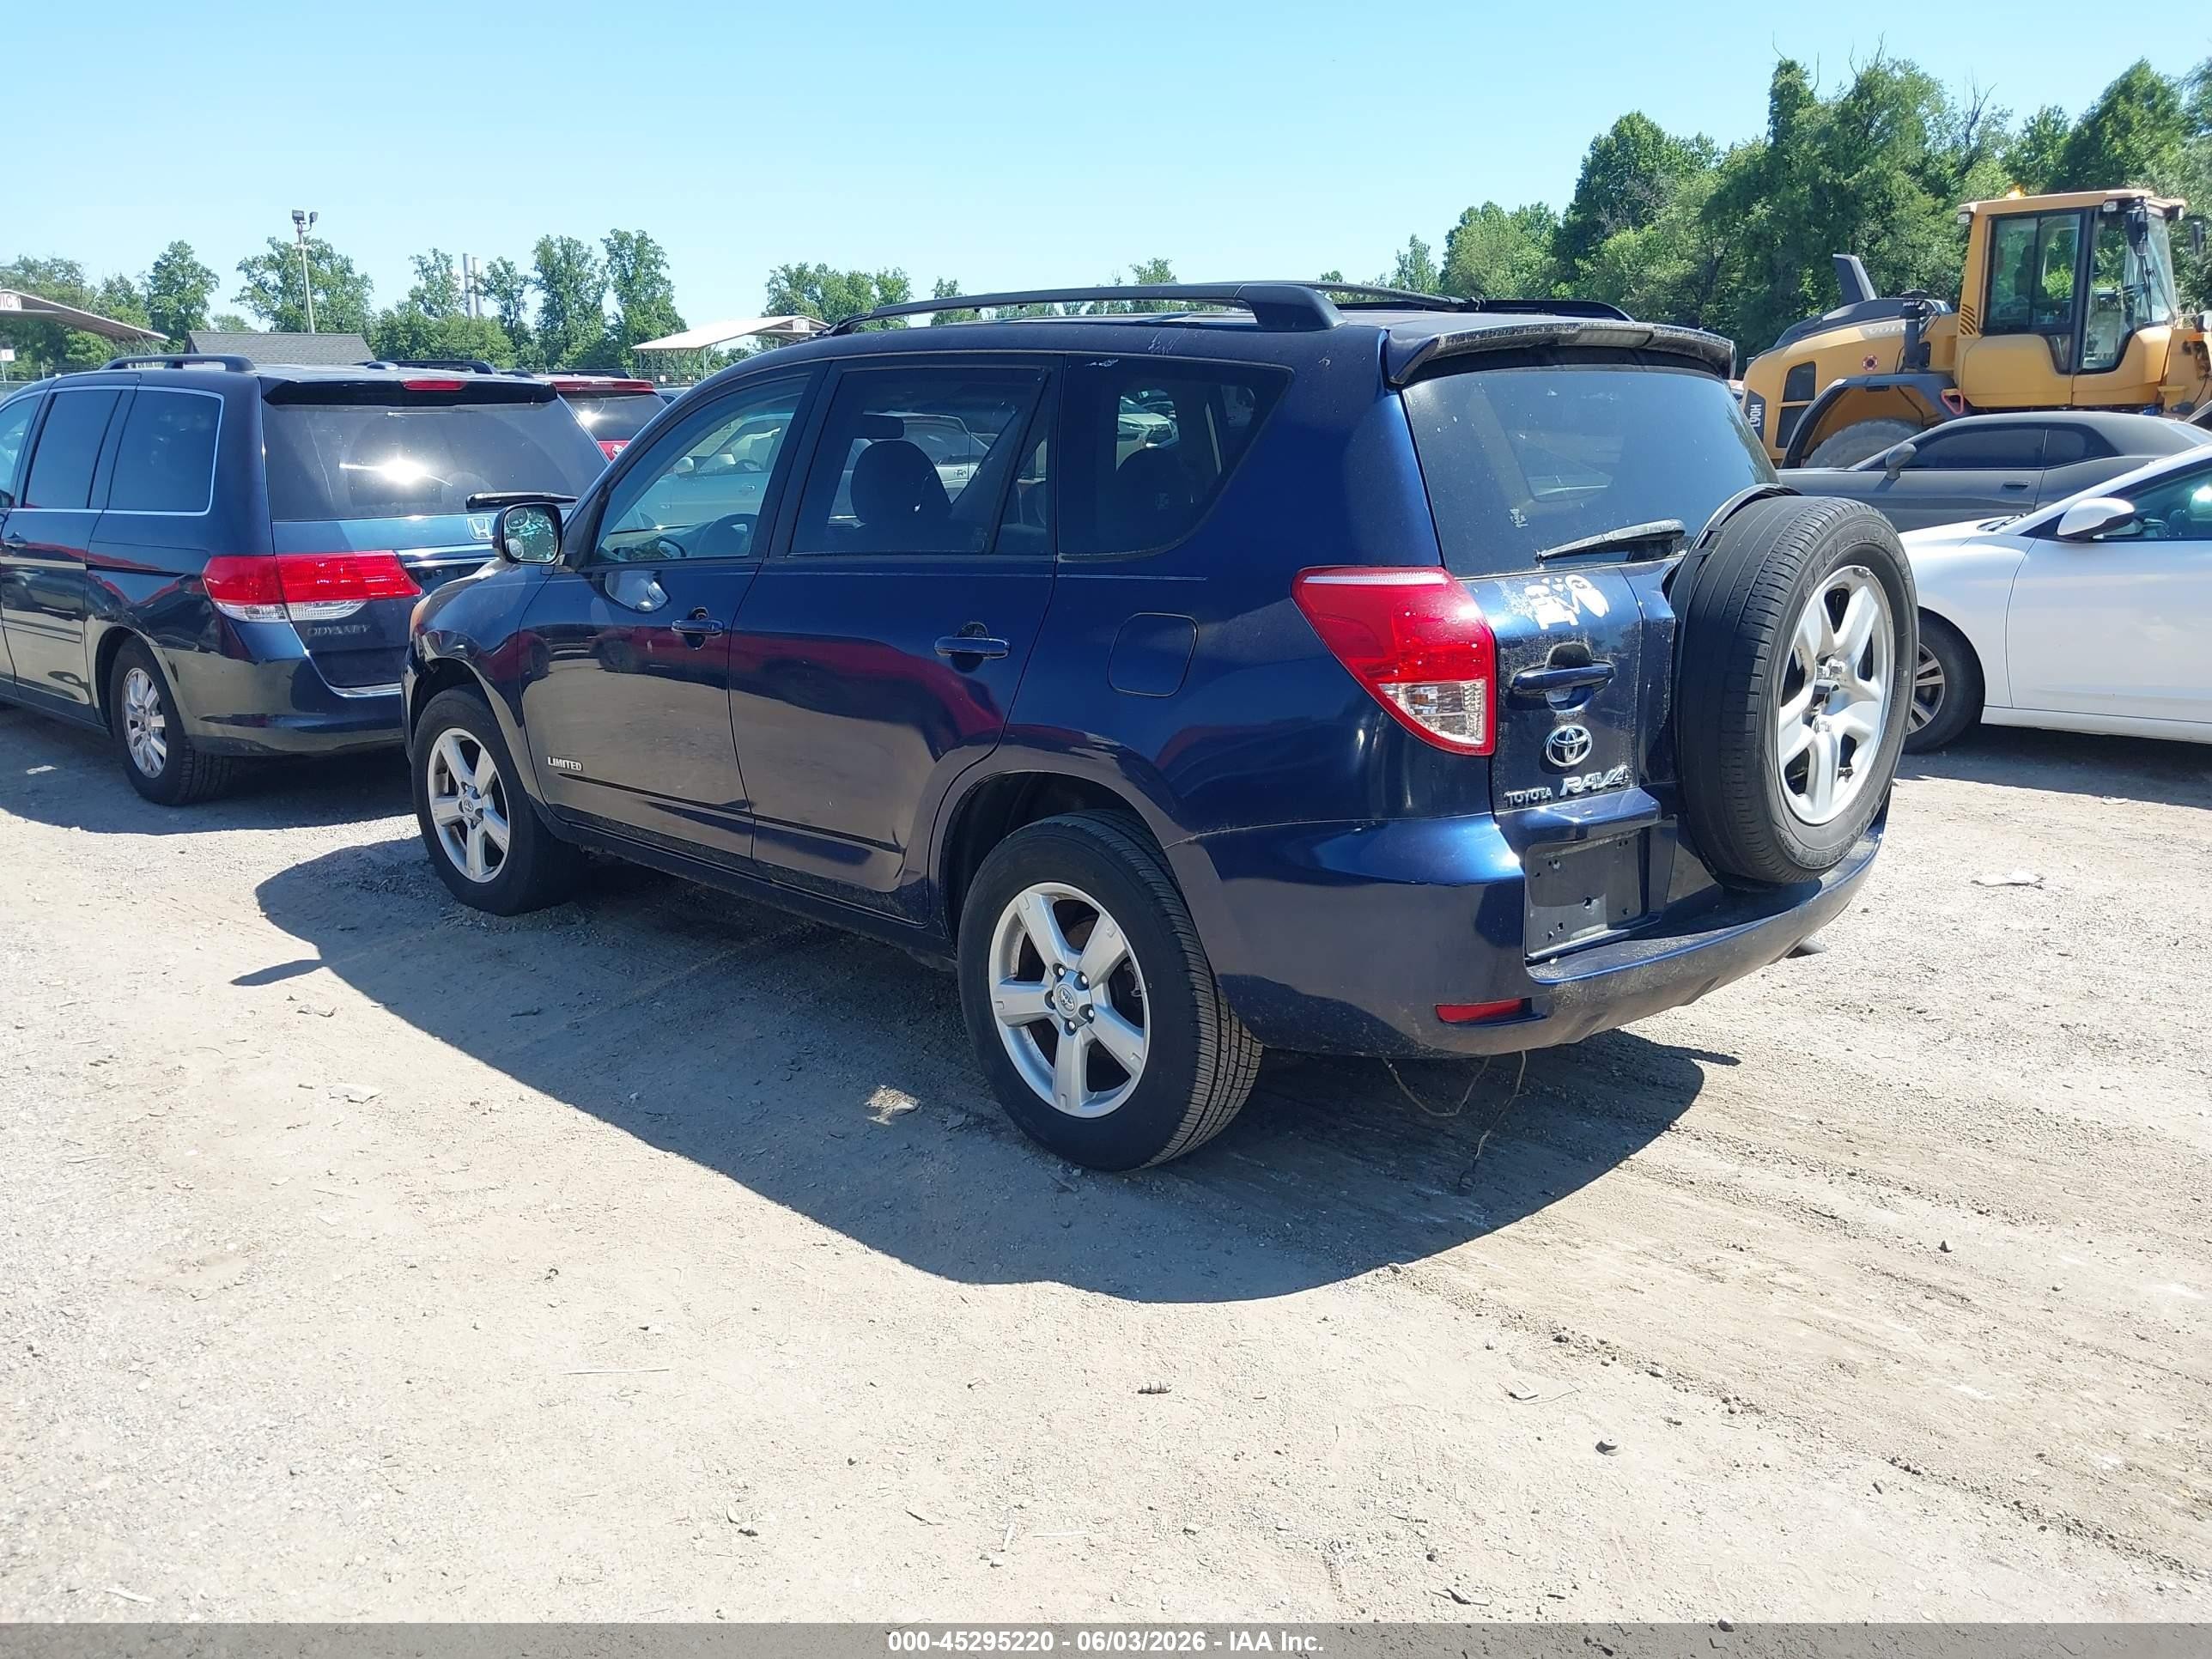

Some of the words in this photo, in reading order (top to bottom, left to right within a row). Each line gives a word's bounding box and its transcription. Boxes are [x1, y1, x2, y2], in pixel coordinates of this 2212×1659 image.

[1749, 404, 1762, 428] L90H
[547, 756, 583, 772] LIMITED
[1504, 787, 1553, 805] TOYOTA
[1559, 763, 1630, 798] RAV4
